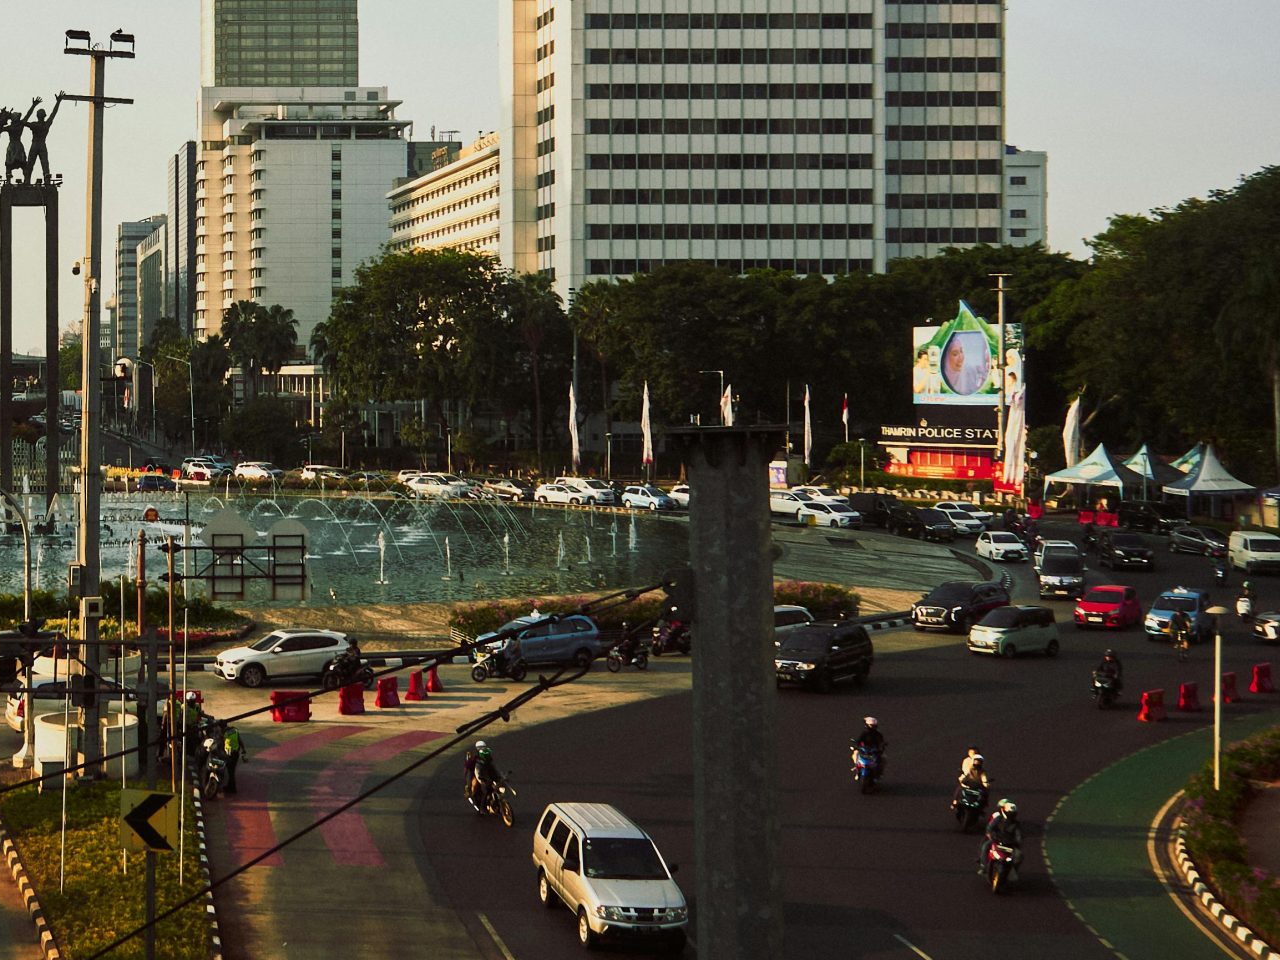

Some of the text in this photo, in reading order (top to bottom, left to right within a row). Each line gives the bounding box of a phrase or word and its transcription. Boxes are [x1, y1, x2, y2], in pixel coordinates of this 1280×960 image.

[881, 425, 1000, 439] THAMRIN POLICE STAT
